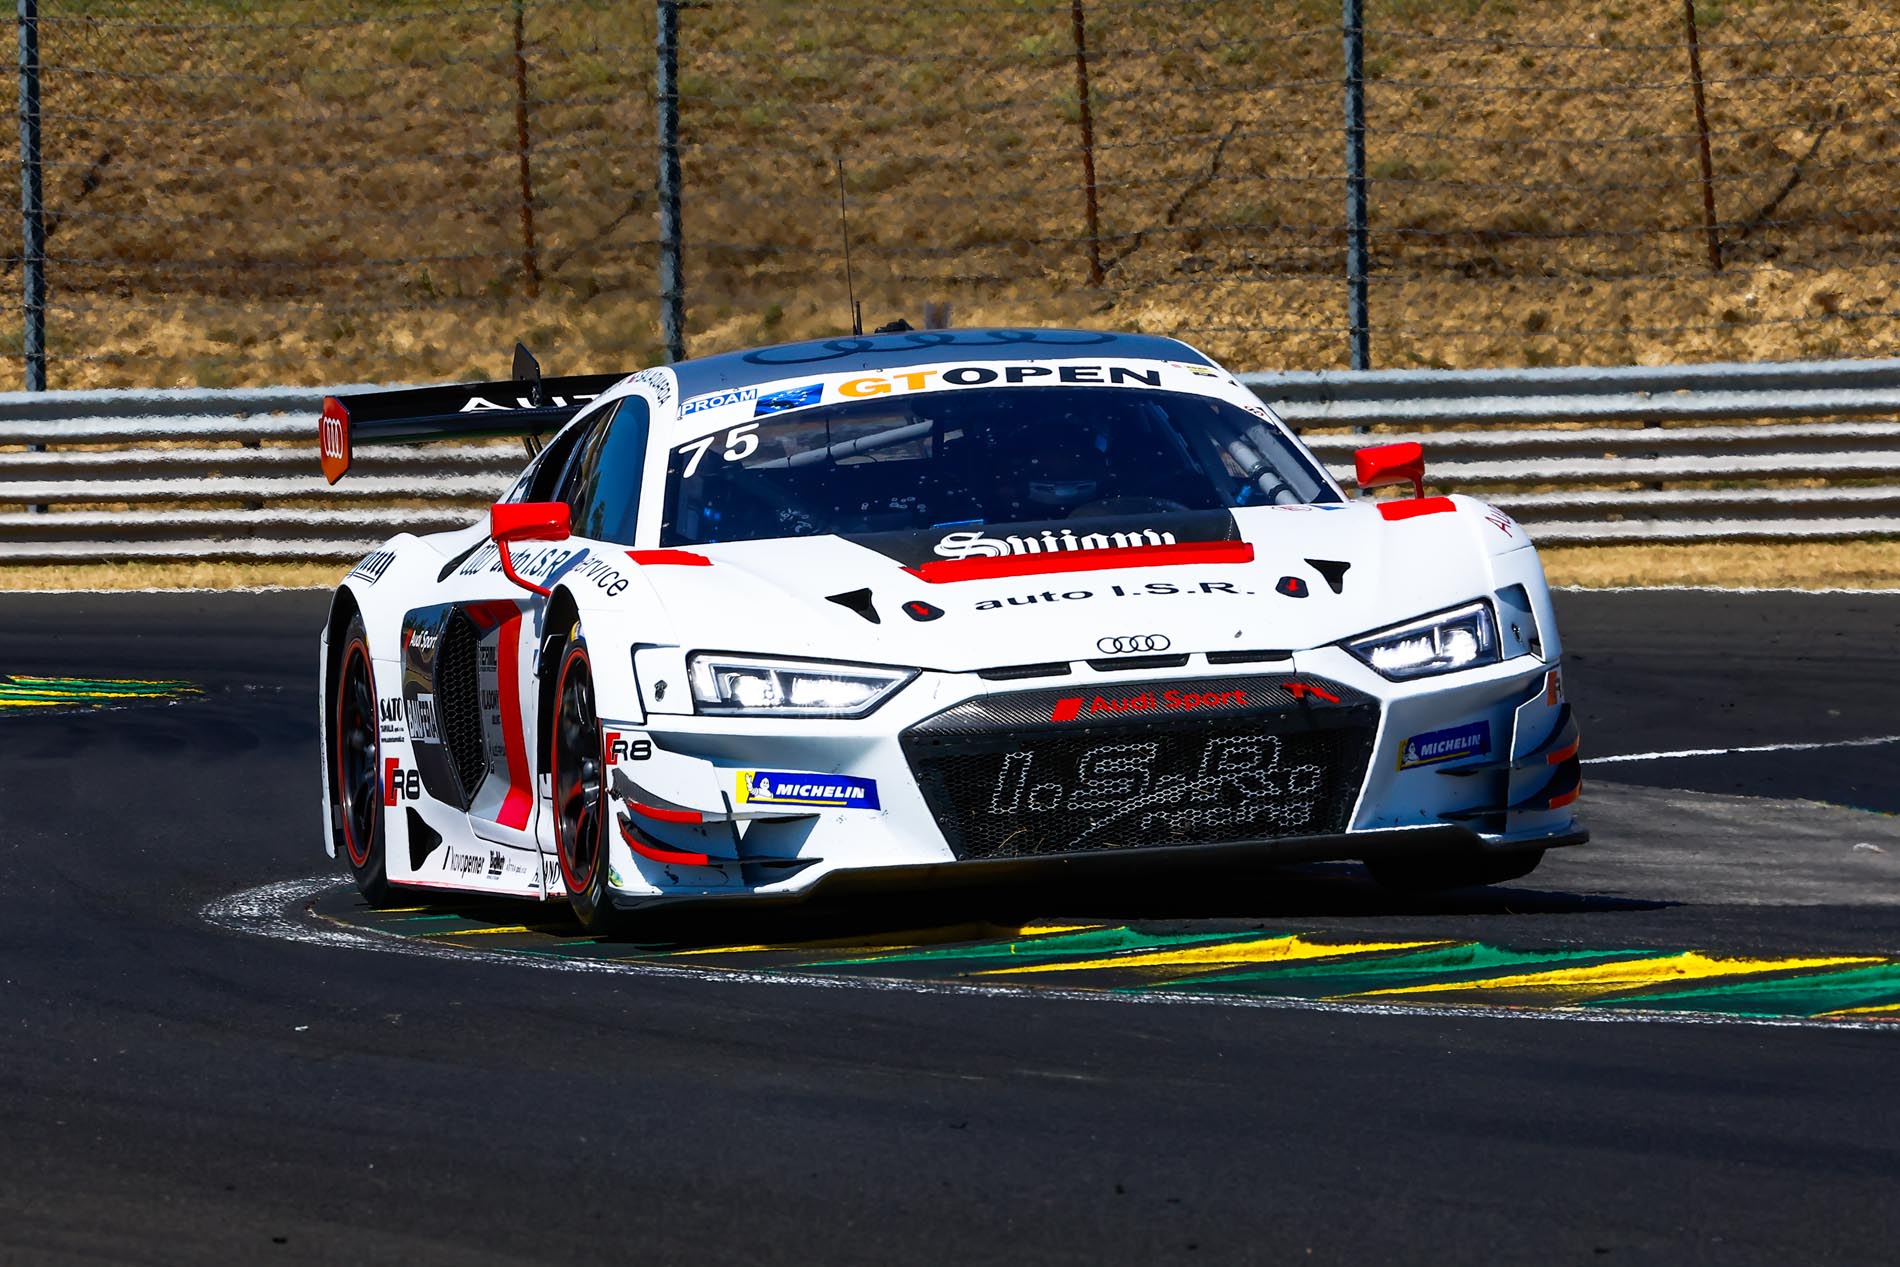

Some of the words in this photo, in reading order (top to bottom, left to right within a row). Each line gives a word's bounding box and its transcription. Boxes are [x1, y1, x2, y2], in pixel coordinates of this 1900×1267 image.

[681, 389, 757, 416] PROAM
[679, 423, 760, 479] 75
[975, 590, 1093, 611] auto
[1112, 582, 1256, 597] I.S.R.
[409, 629, 424, 648] Audi
[421, 630, 438, 653] Sport
[380, 697, 403, 722] SATO
[1089, 692, 1157, 714] Audi
[1162, 690, 1248, 712] Sport
[612, 740, 652, 761] R8
[1420, 734, 1481, 757] MICHELIN
[391, 769, 420, 800] R8
[775, 783, 865, 799] MICHELIN
